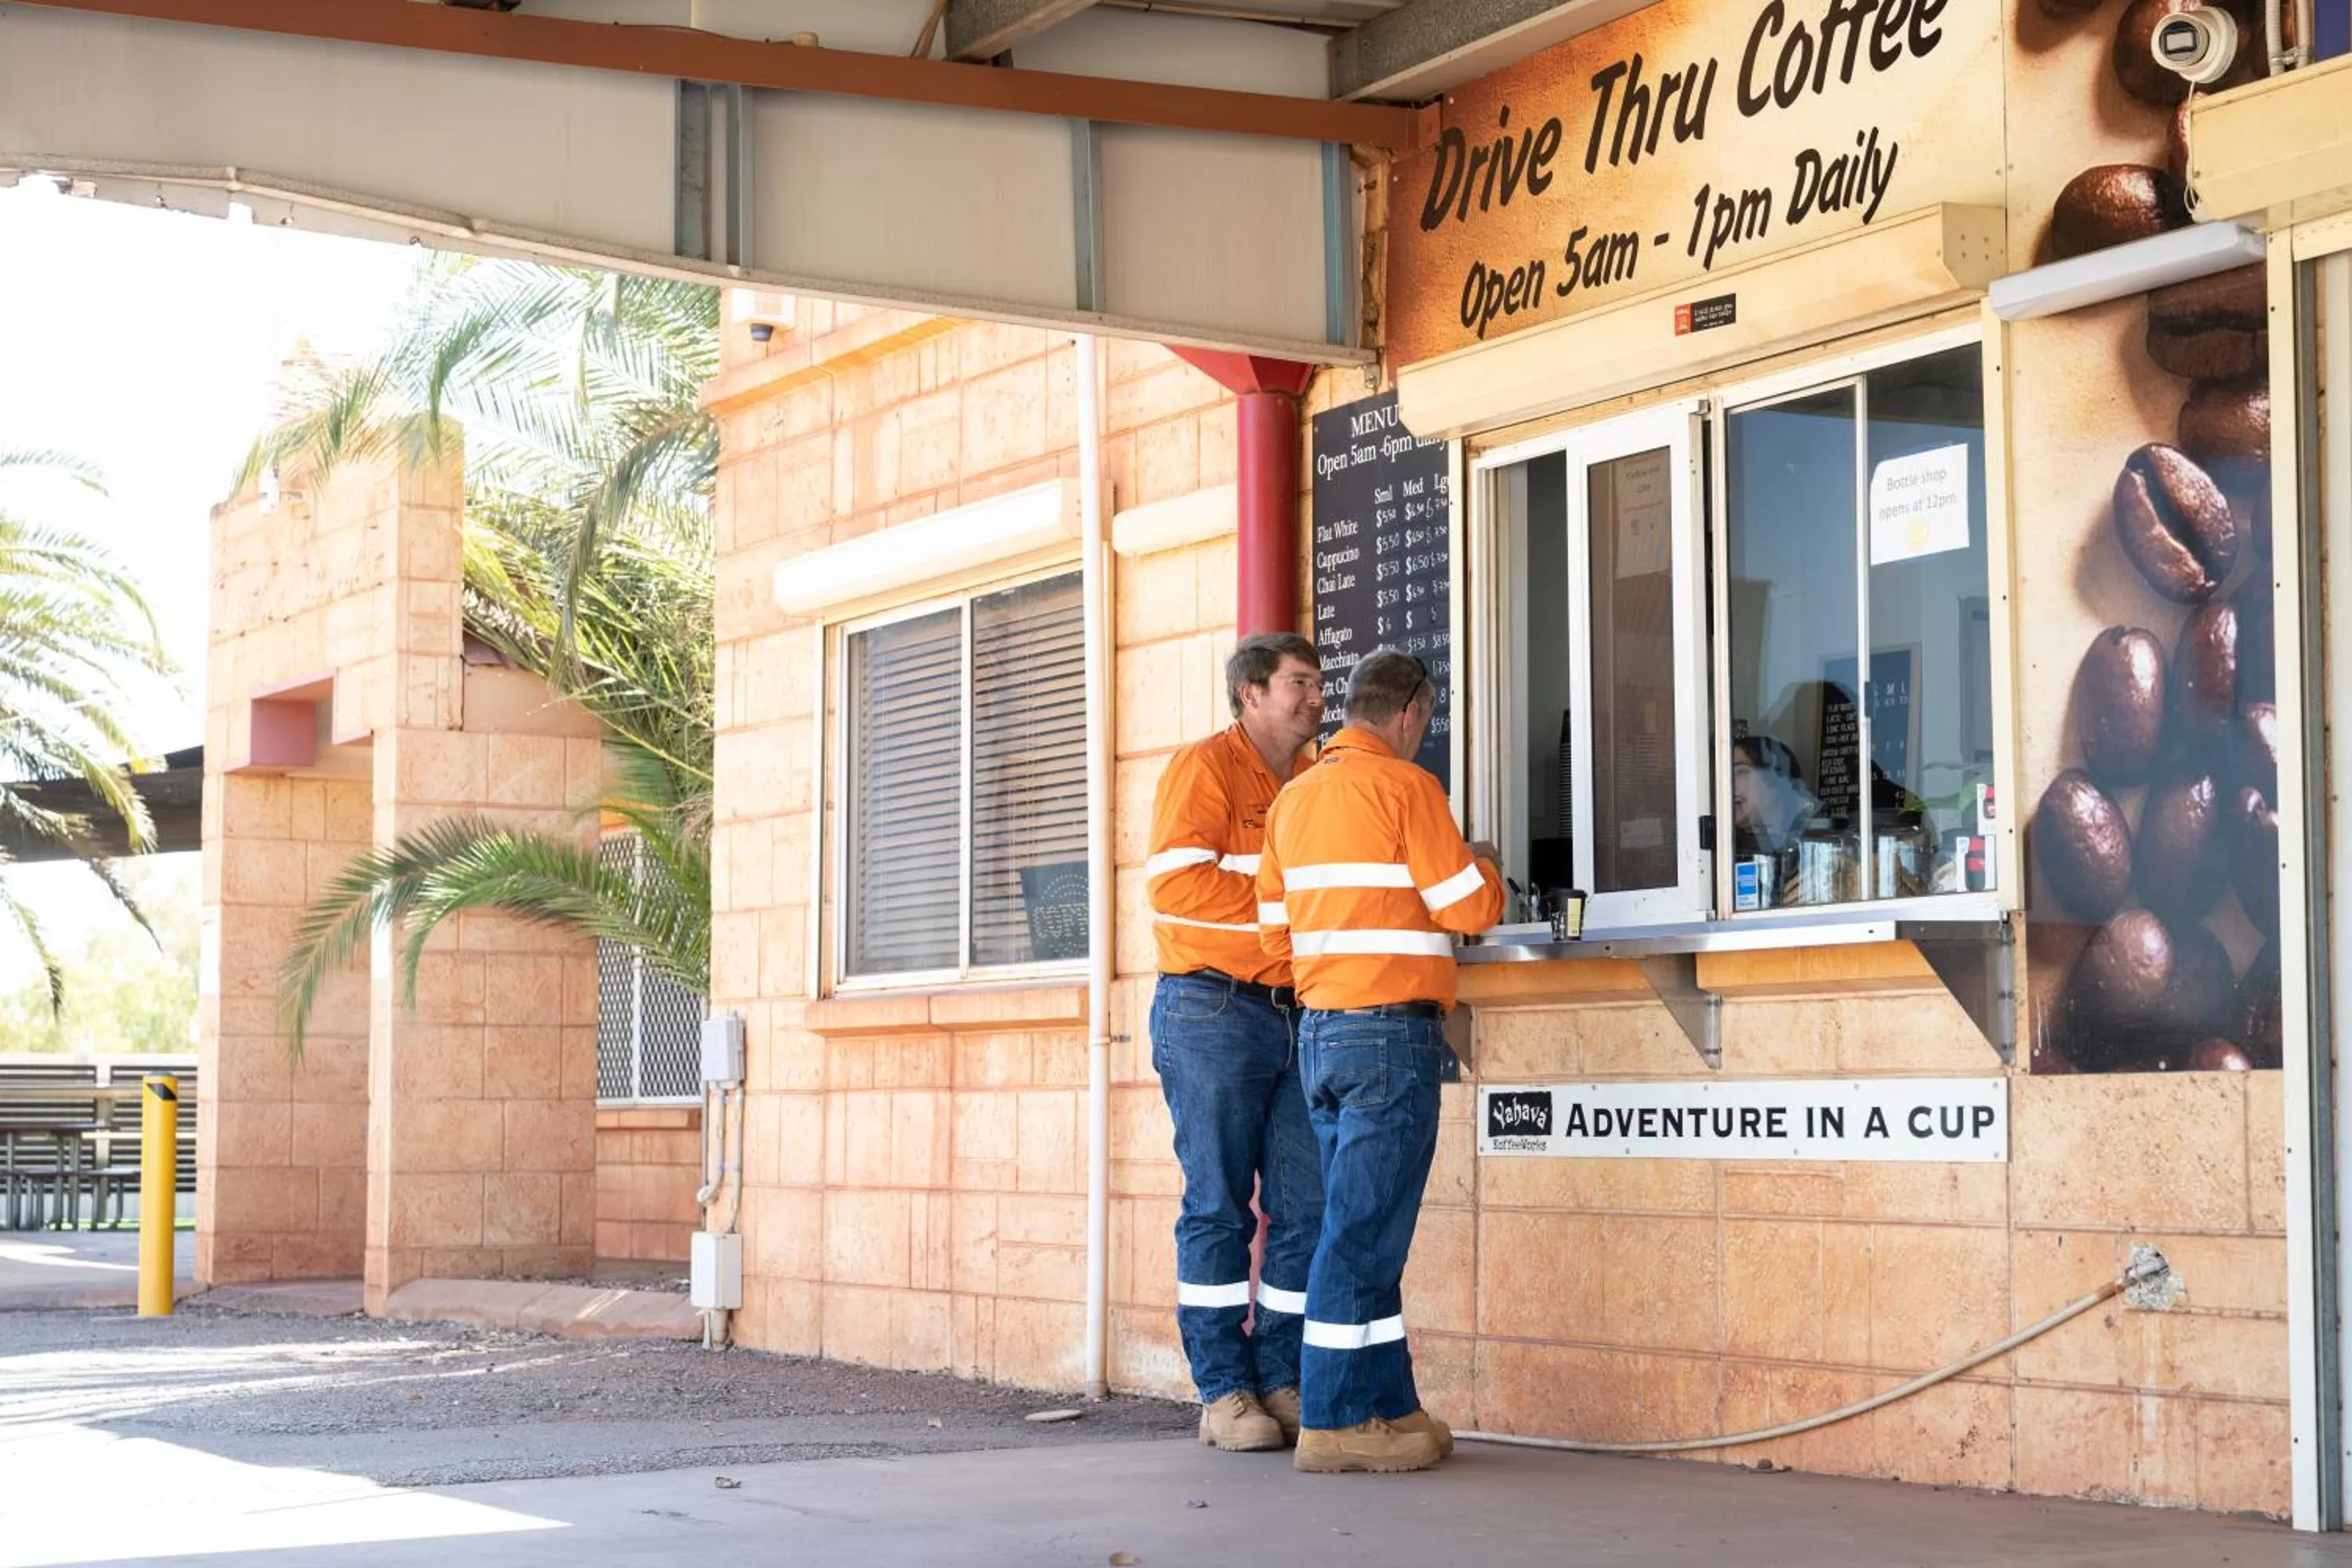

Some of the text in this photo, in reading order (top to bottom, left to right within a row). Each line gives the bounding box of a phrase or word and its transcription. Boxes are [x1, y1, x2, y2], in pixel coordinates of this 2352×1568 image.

[1420, 0, 1944, 233] Drive Thru Coffee
[1461, 260, 1544, 339] Open
[1556, 225, 1639, 297] 5am
[1687, 183, 1772, 271] 1pm
[1786, 126, 1899, 226] Daily
[1350, 404, 1398, 437] MENU
[1318, 454, 1348, 481] Open
[1350, 445, 1377, 466] 5am
[1403, 477, 1423, 497] Med
[1886, 469, 1947, 491] Bottle shop
[1880, 493, 1956, 522] opens at 12pm
[1317, 524, 1333, 543] Flat
[1334, 520, 1359, 539] White
[1317, 575, 1336, 593] Chai
[1493, 1096, 1546, 1129] Yahava
[1566, 1103, 1996, 1139] ADVENTURE IN A CUP
